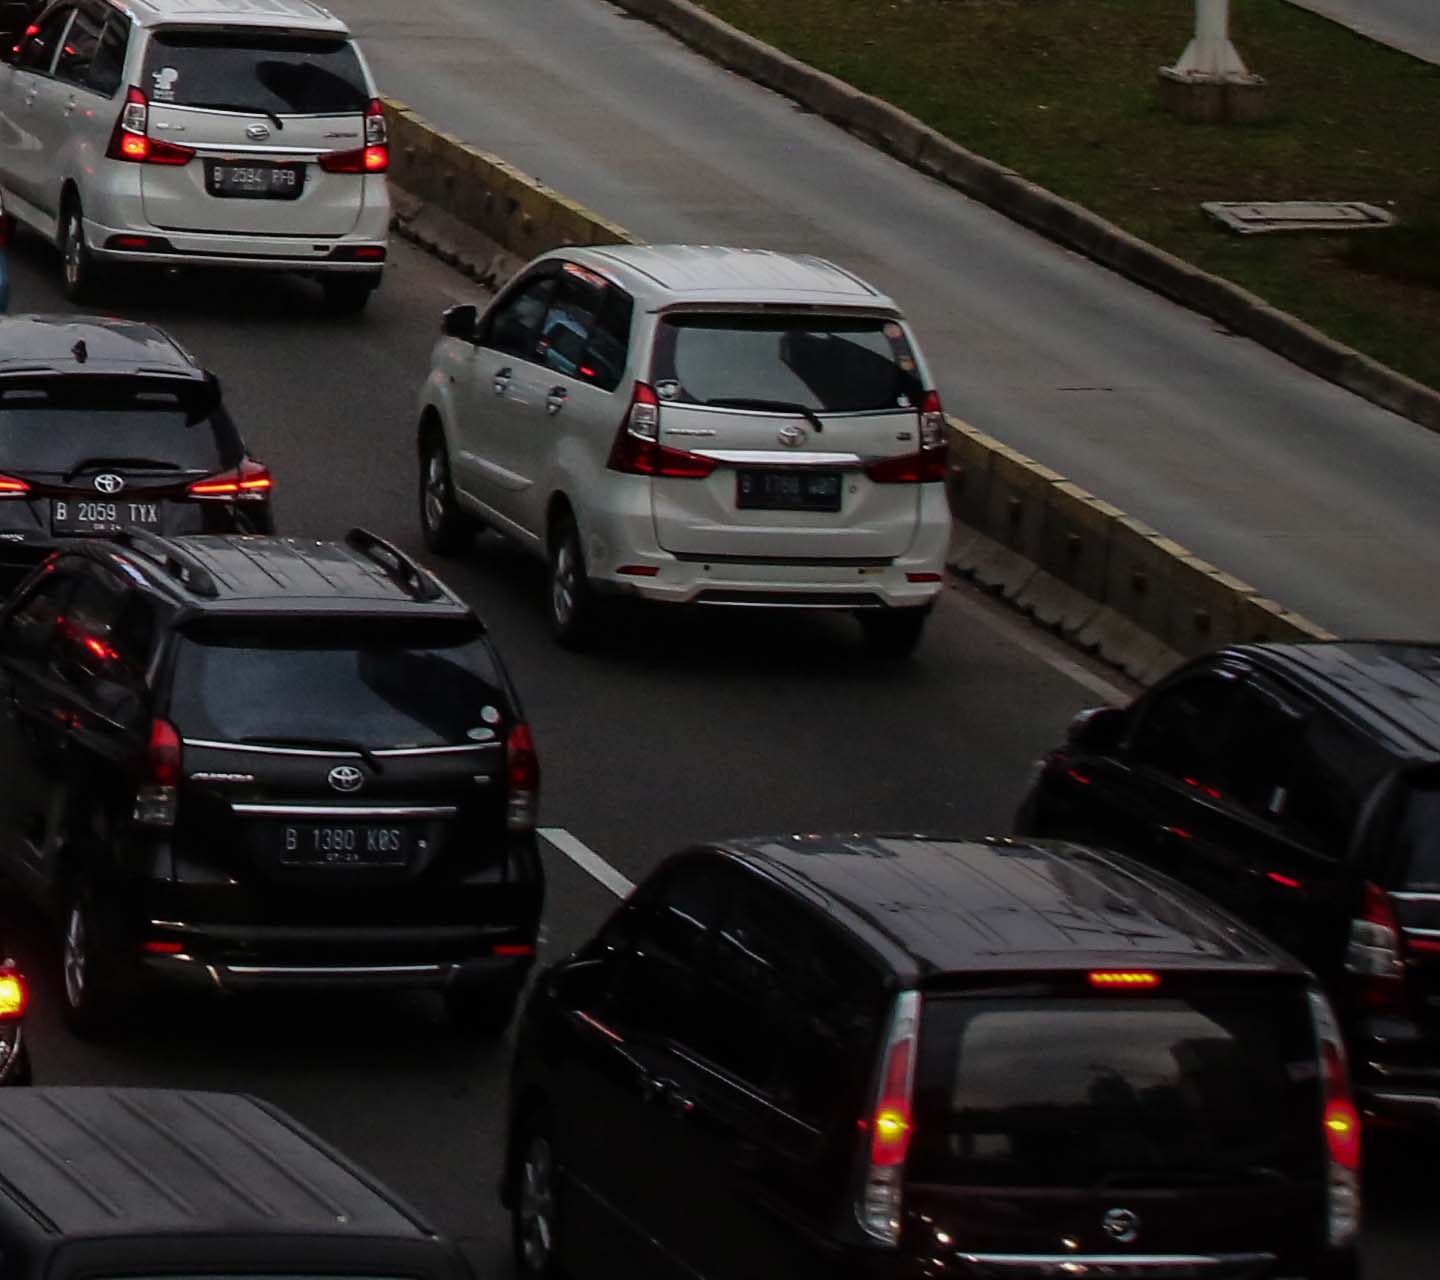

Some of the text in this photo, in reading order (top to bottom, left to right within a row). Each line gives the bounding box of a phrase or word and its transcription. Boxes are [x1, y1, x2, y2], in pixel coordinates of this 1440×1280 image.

[55, 501, 158, 524] B 2059 TYX
[285, 828, 298, 851] B
[312, 828, 355, 851] 1380
